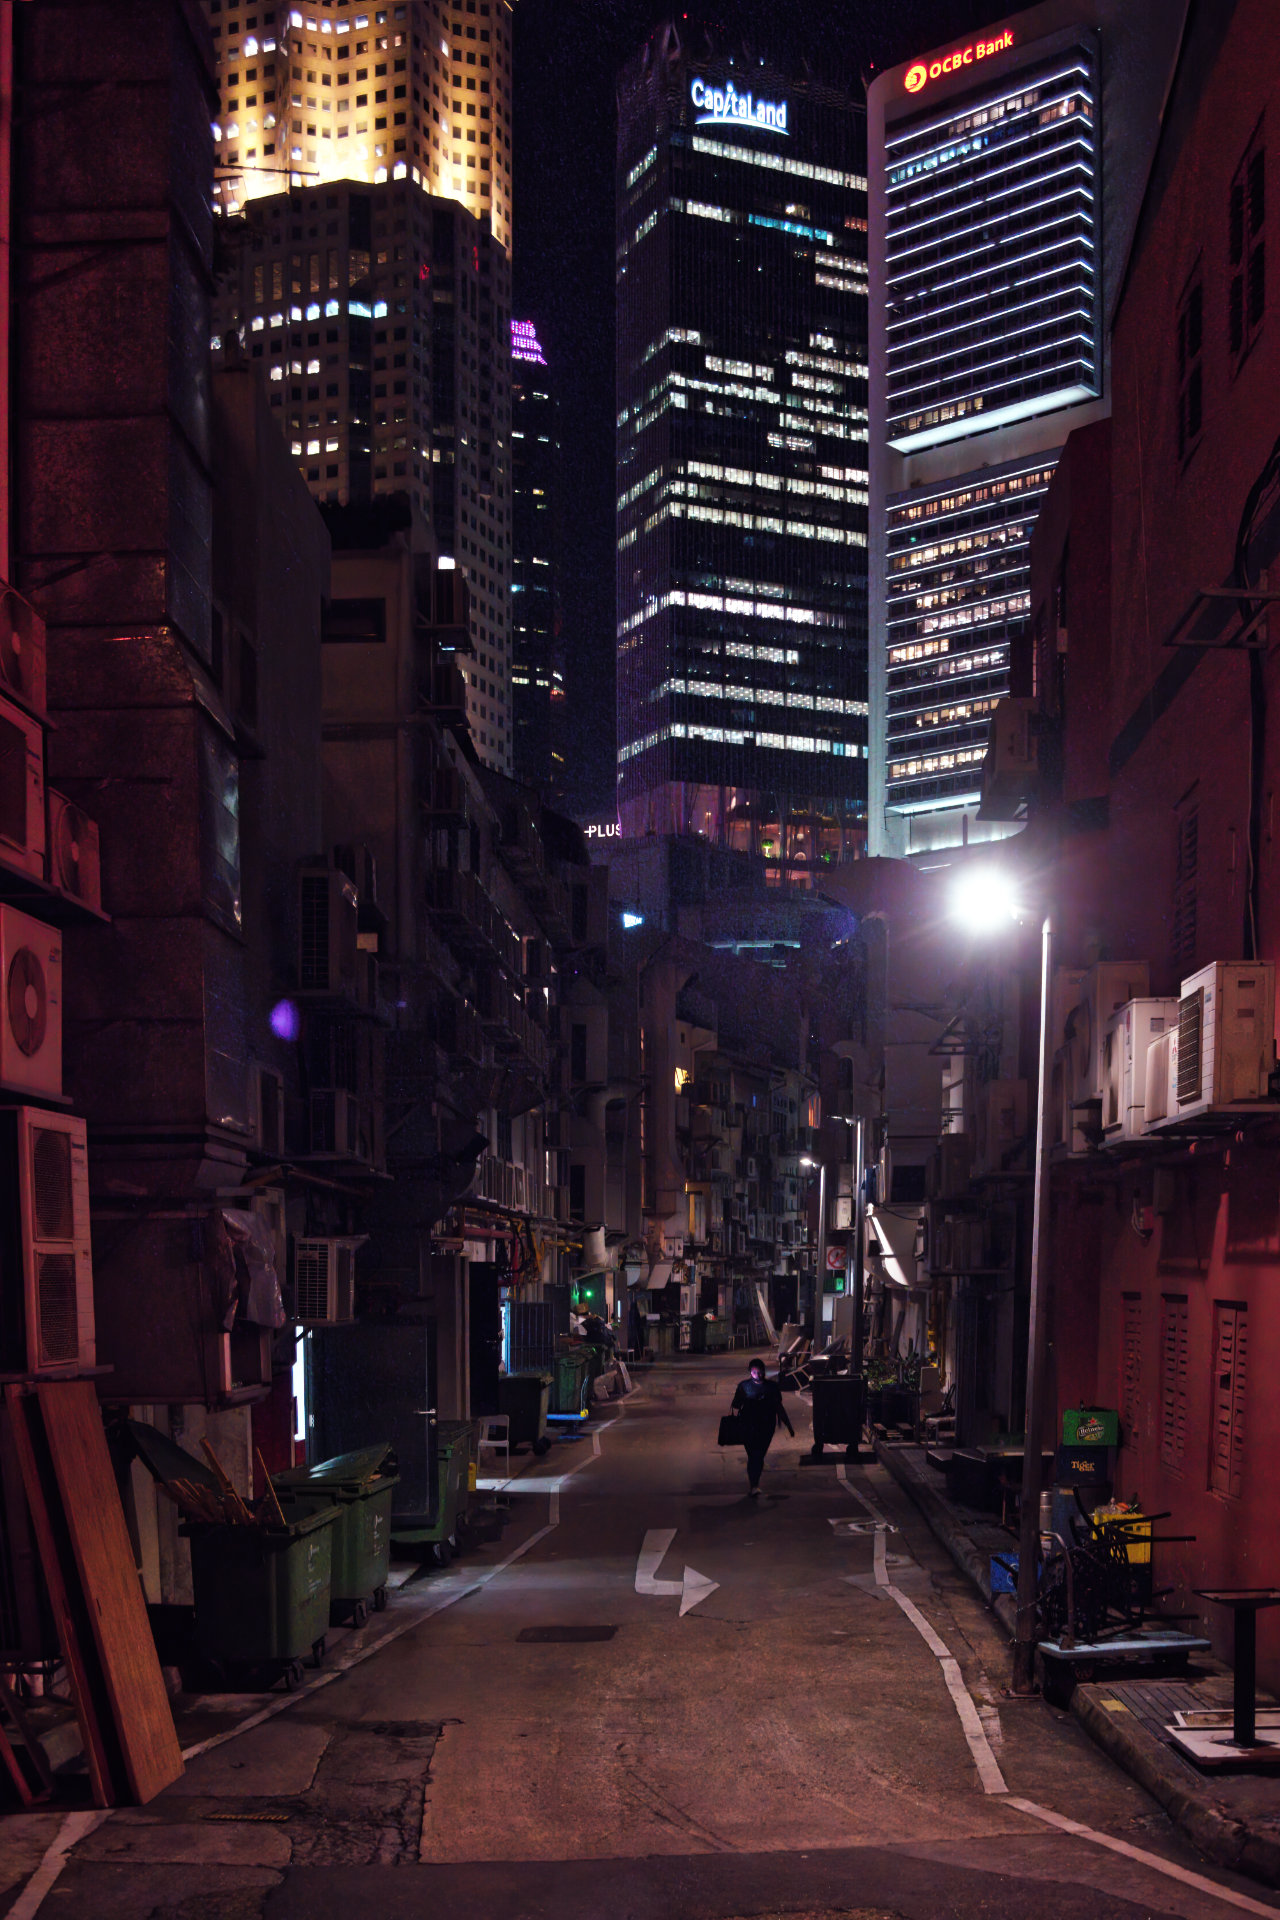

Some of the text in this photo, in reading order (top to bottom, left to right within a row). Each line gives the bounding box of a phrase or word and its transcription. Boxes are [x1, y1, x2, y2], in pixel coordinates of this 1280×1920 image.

[929, 32, 1013, 79] OCBC Bank
[692, 81, 787, 129] CapitaLand
[1071, 1459, 1096, 1472] Tiger
